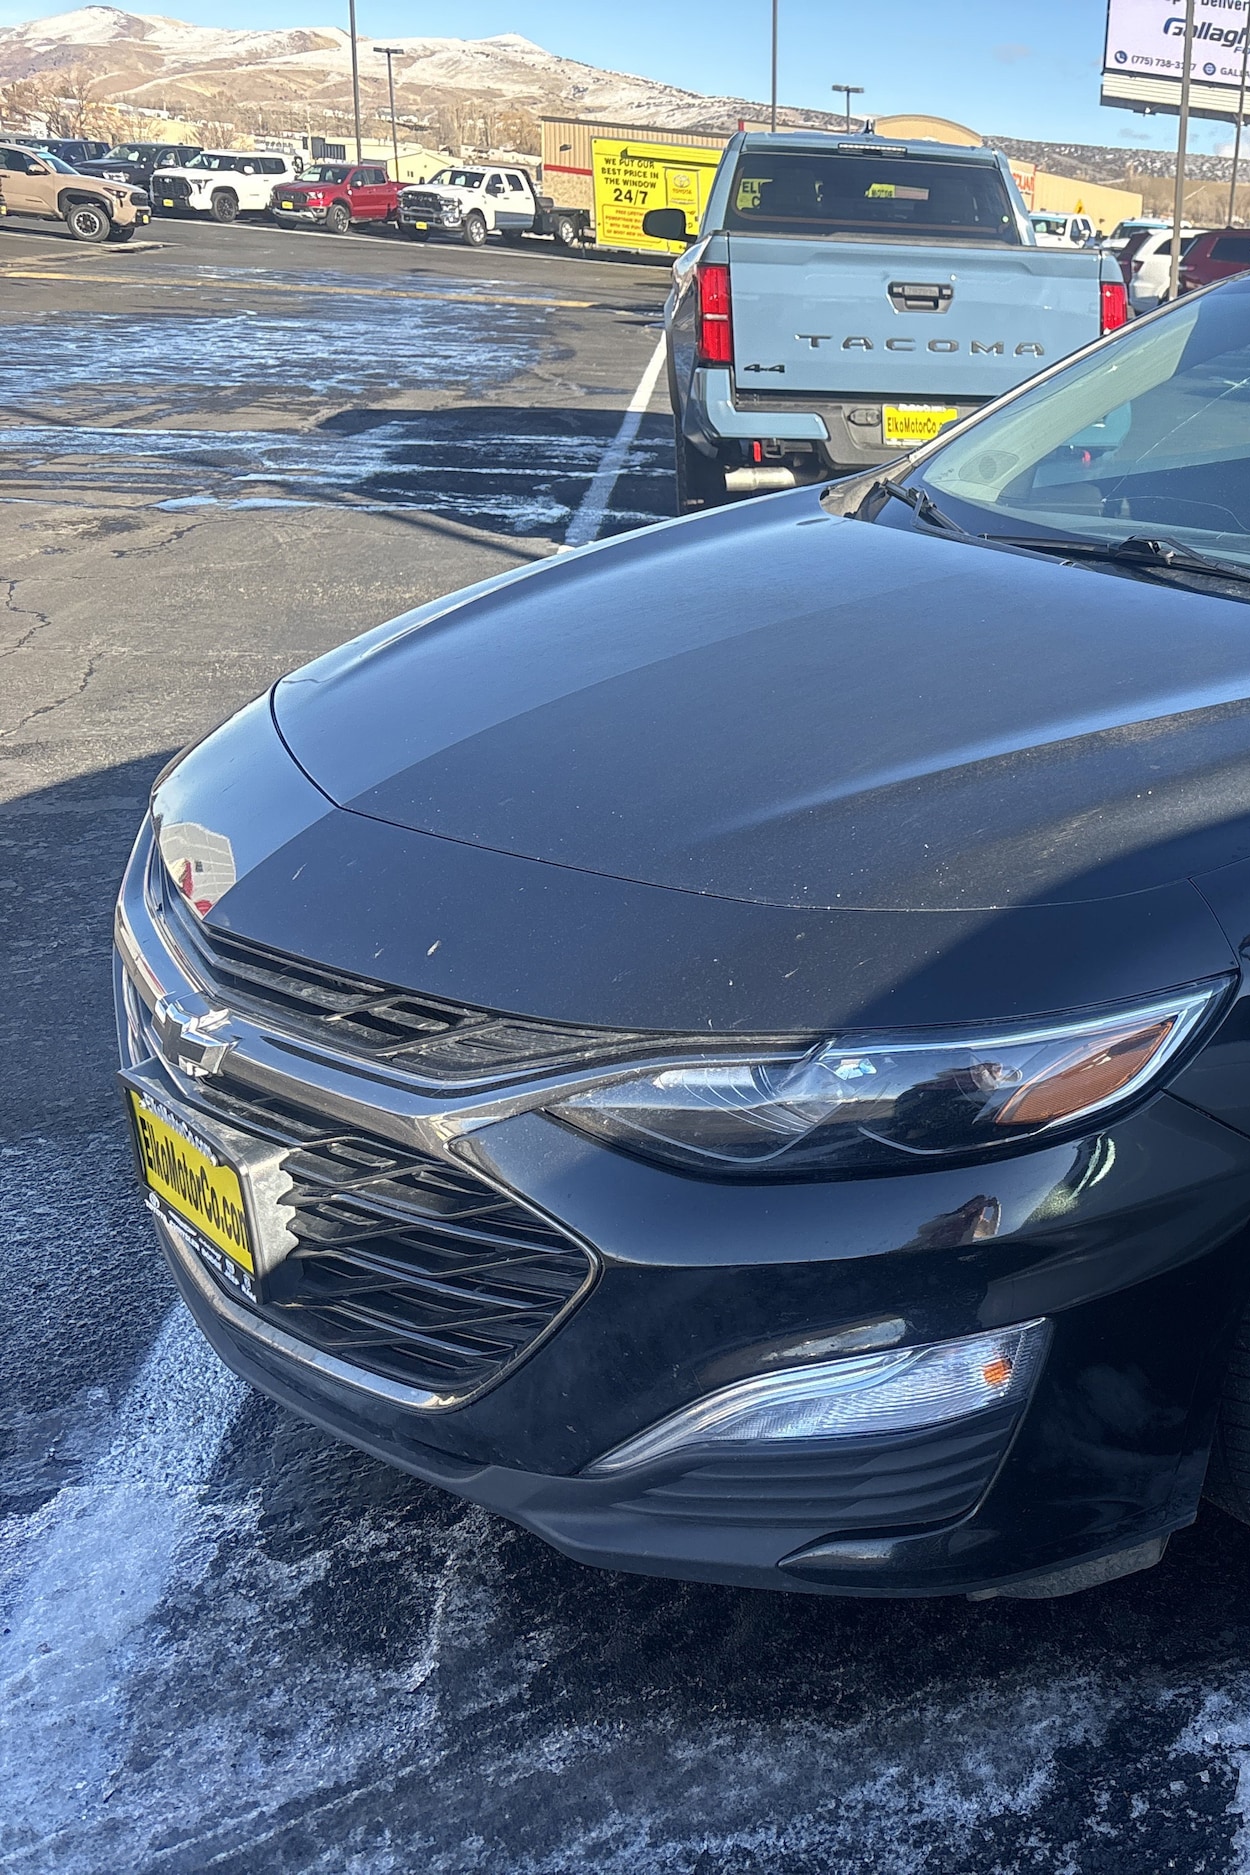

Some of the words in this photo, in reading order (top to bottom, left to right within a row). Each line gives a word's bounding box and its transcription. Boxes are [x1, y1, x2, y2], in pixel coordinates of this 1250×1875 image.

[1131, 55, 1153, 66] (775)
[637, 160, 654, 169] OUR
[601, 167, 621, 175] BEST
[623, 169, 647, 178] PRICE
[604, 177, 620, 185] THE
[622, 179, 656, 189] WINDOW
[613, 187, 648, 205] 24/7
[794, 334, 1045, 358] TACOMA
